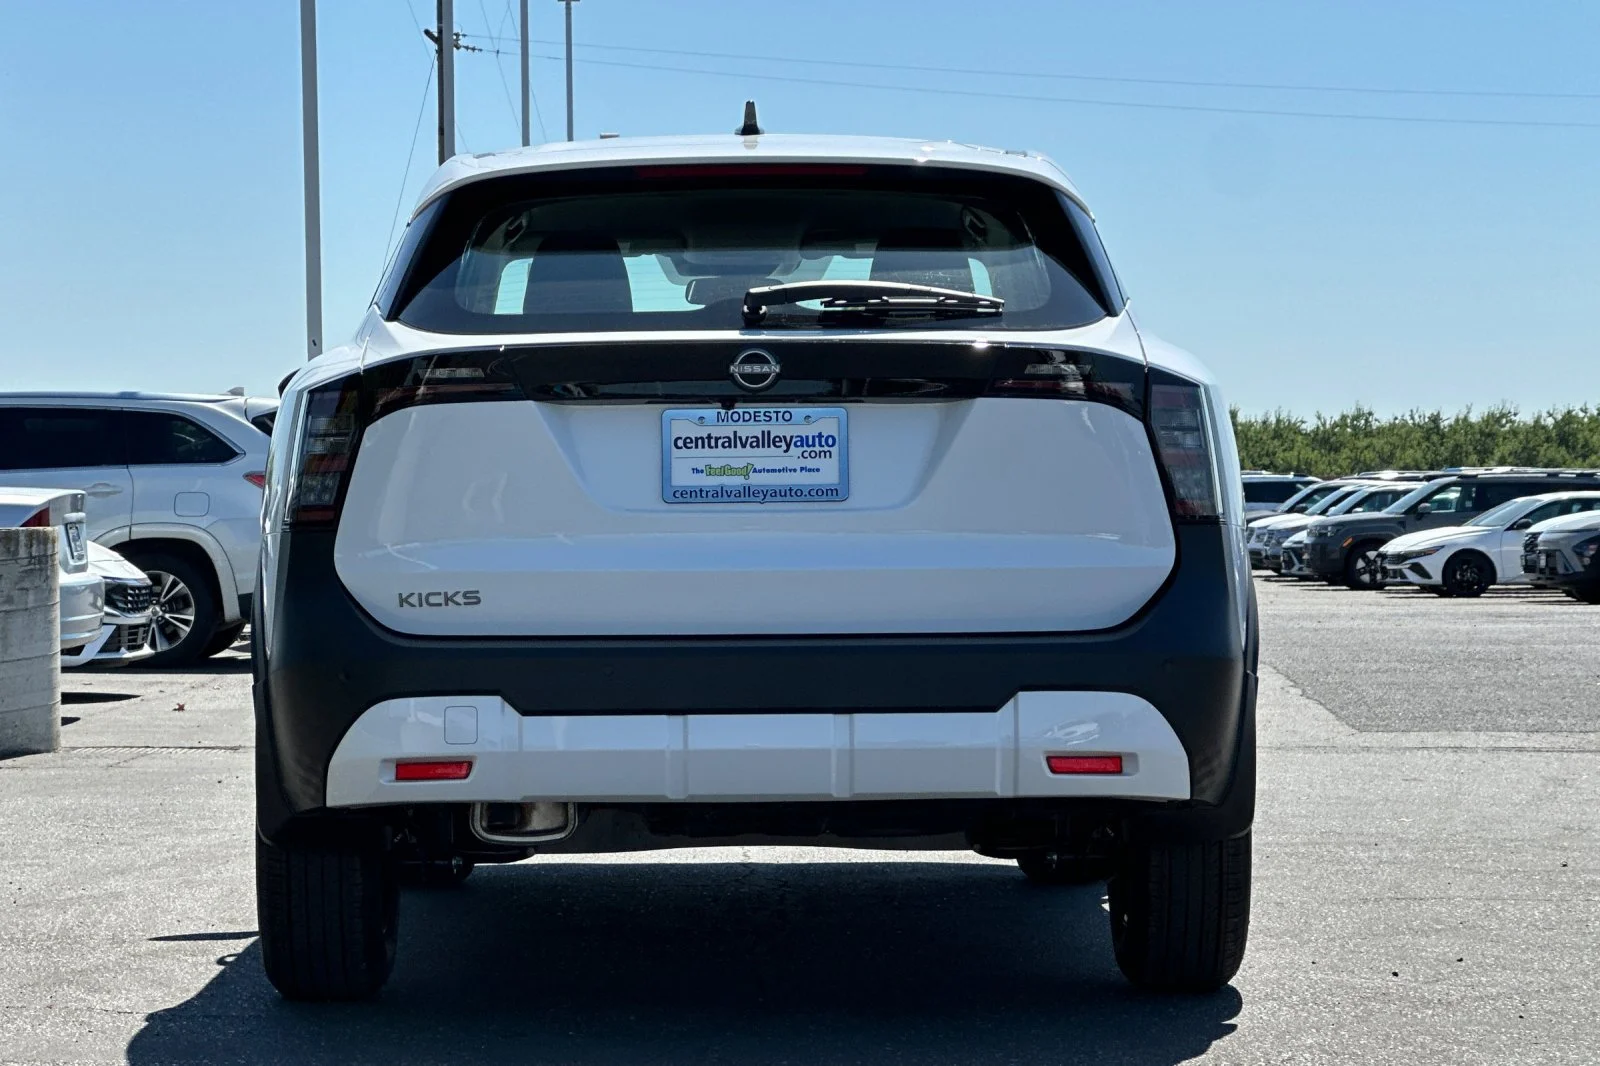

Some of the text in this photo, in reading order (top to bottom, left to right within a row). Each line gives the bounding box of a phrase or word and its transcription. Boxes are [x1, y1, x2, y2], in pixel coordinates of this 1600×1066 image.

[730, 365, 780, 373] NISSAN
[716, 410, 793, 423] MODESTO
[673, 430, 837, 453] centralvalleyauto
[797, 449, 832, 459] .com
[752, 466, 798, 474] Automotive
[672, 486, 839, 500] centralvalleyauto.com
[398, 590, 482, 608] KICKS
